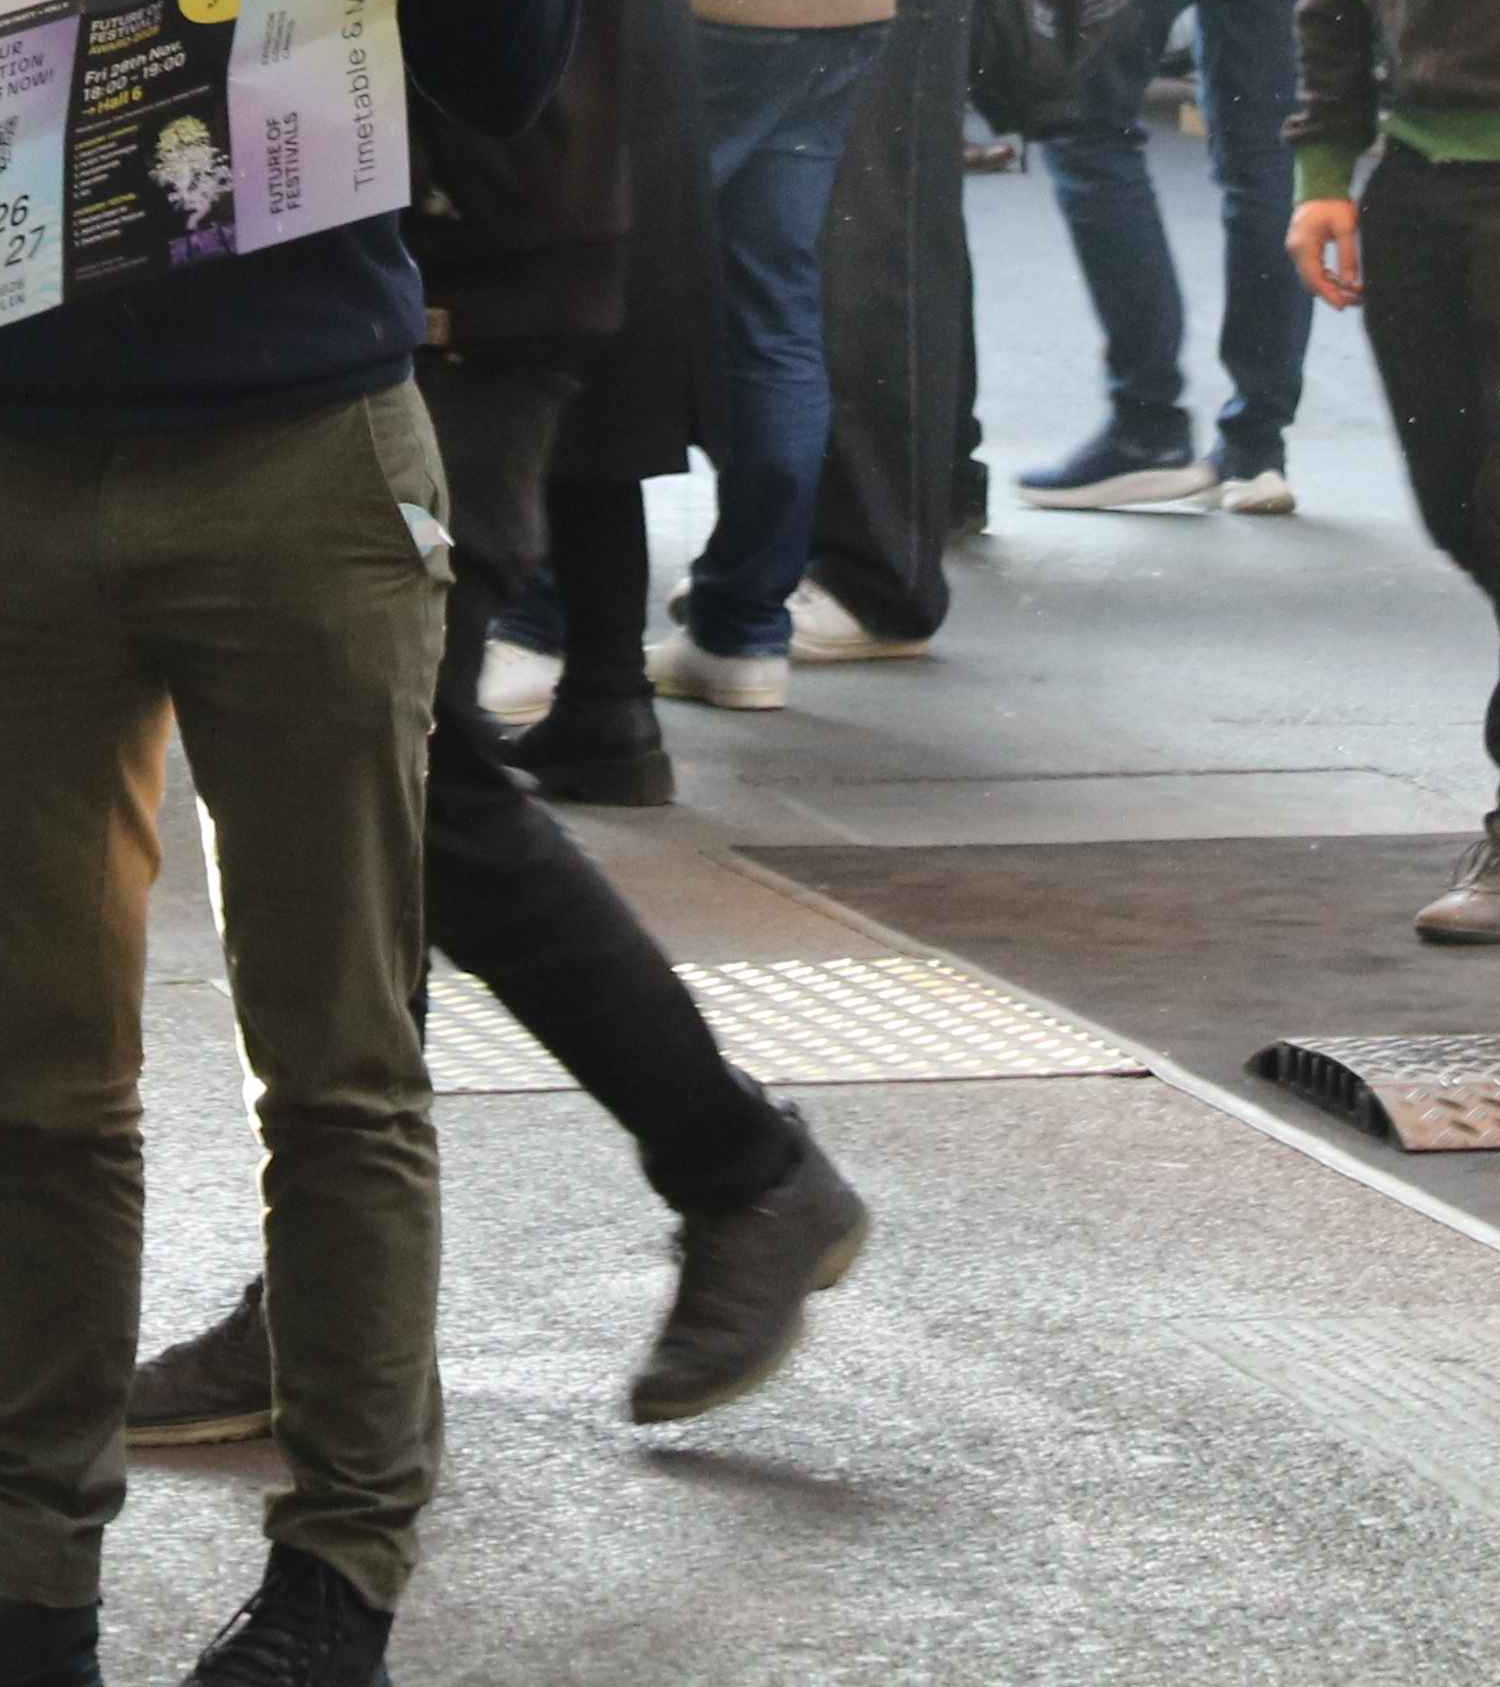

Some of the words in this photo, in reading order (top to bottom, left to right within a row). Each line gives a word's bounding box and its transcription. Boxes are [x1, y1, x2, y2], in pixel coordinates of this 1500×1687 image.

[90, 8, 146, 33] FUTURE
[7, 68, 55, 96] NOW!
[82, 75, 128, 102] 18:00
[142, 52, 188, 81] 19:00
[84, 67, 108, 86] Fri
[267, 118, 283, 143] OF
[350, 48, 375, 192] Timetable
[268, 144, 285, 214] FUTURE
[284, 111, 303, 212] FESTIVALS
[4, 225, 47, 269] 27
